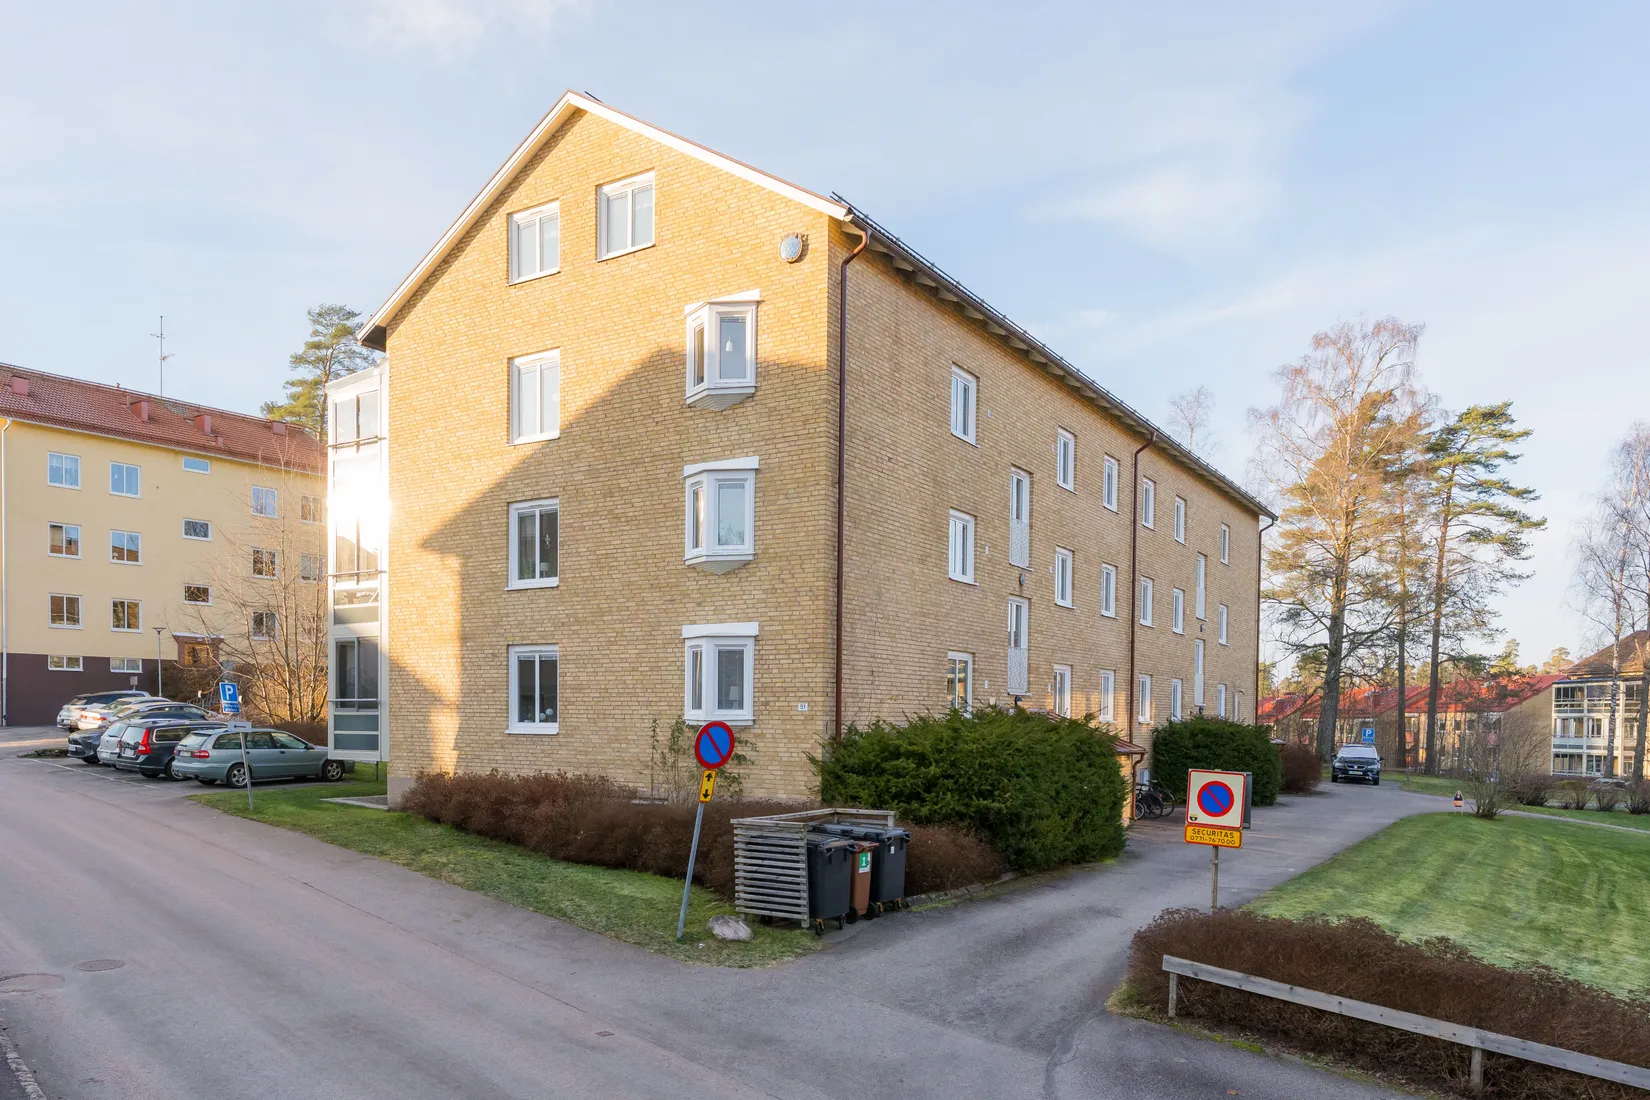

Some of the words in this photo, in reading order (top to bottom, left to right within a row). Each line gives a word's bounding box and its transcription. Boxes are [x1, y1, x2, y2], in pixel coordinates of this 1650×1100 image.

[225, 685, 233, 700] P
[1366, 729, 1372, 737] P
[1192, 828, 1235, 839] SECURITAS
